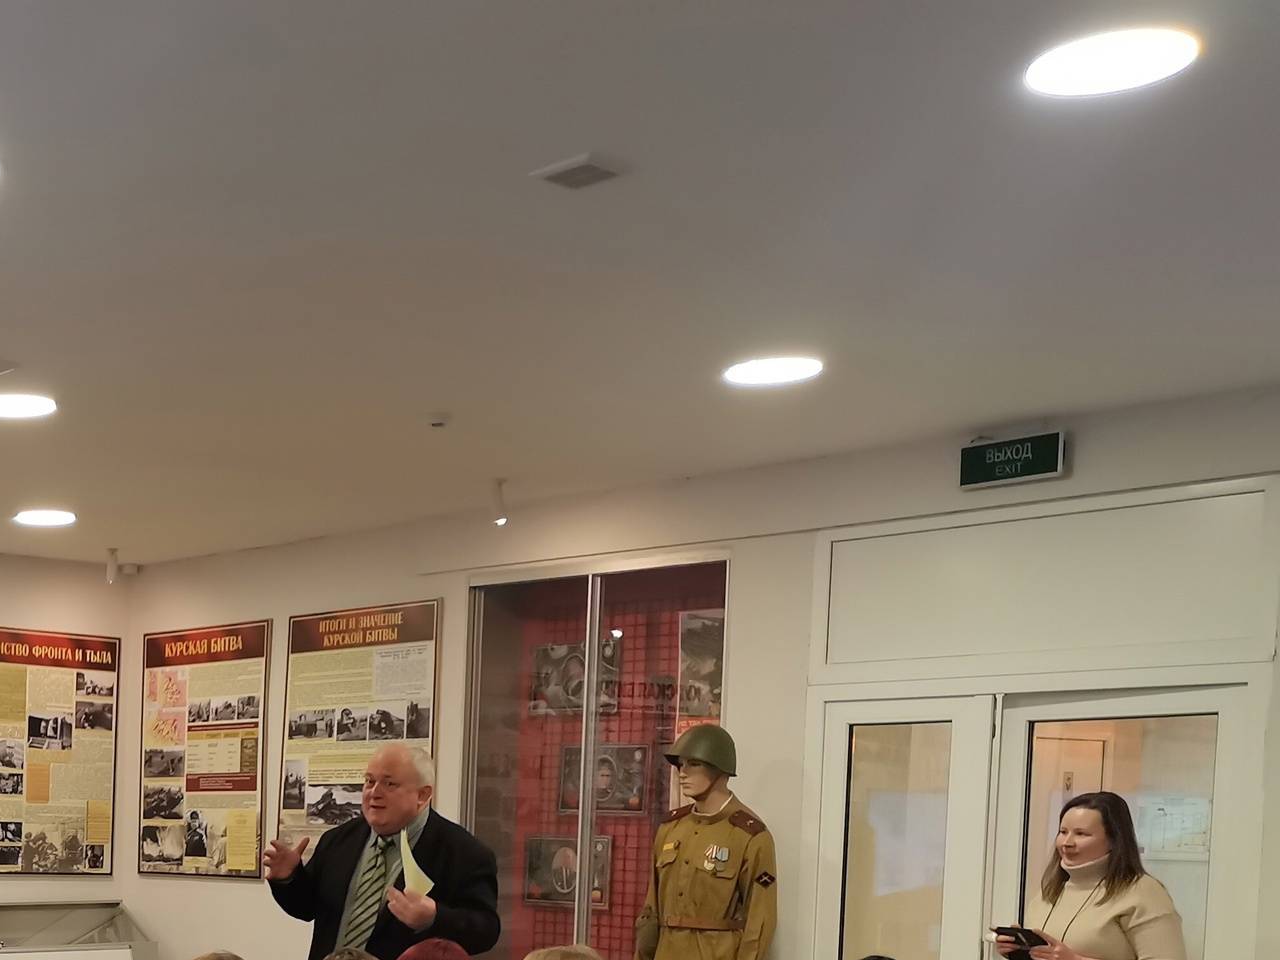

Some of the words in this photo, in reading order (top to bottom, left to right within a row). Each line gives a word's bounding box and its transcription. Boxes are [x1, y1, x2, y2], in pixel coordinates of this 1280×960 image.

[985, 442, 1033, 463] ВЫХОД
[995, 462, 1023, 476] EXIT
[319, 618, 346, 633] ИТОГИ
[348, 617, 356, 630] И
[359, 611, 404, 628] ЗНАЧЕНИЕ
[164, 638, 208, 658] КУРСКАЯ
[210, 635, 243, 654] БИТВА
[323, 631, 363, 647] КУРСКОЙ
[366, 627, 398, 643] БИТВЫ
[31, 644, 72, 661] ФРОНТА
[75, 648, 83, 662] И
[85, 649, 112, 664] ТЫЛА
